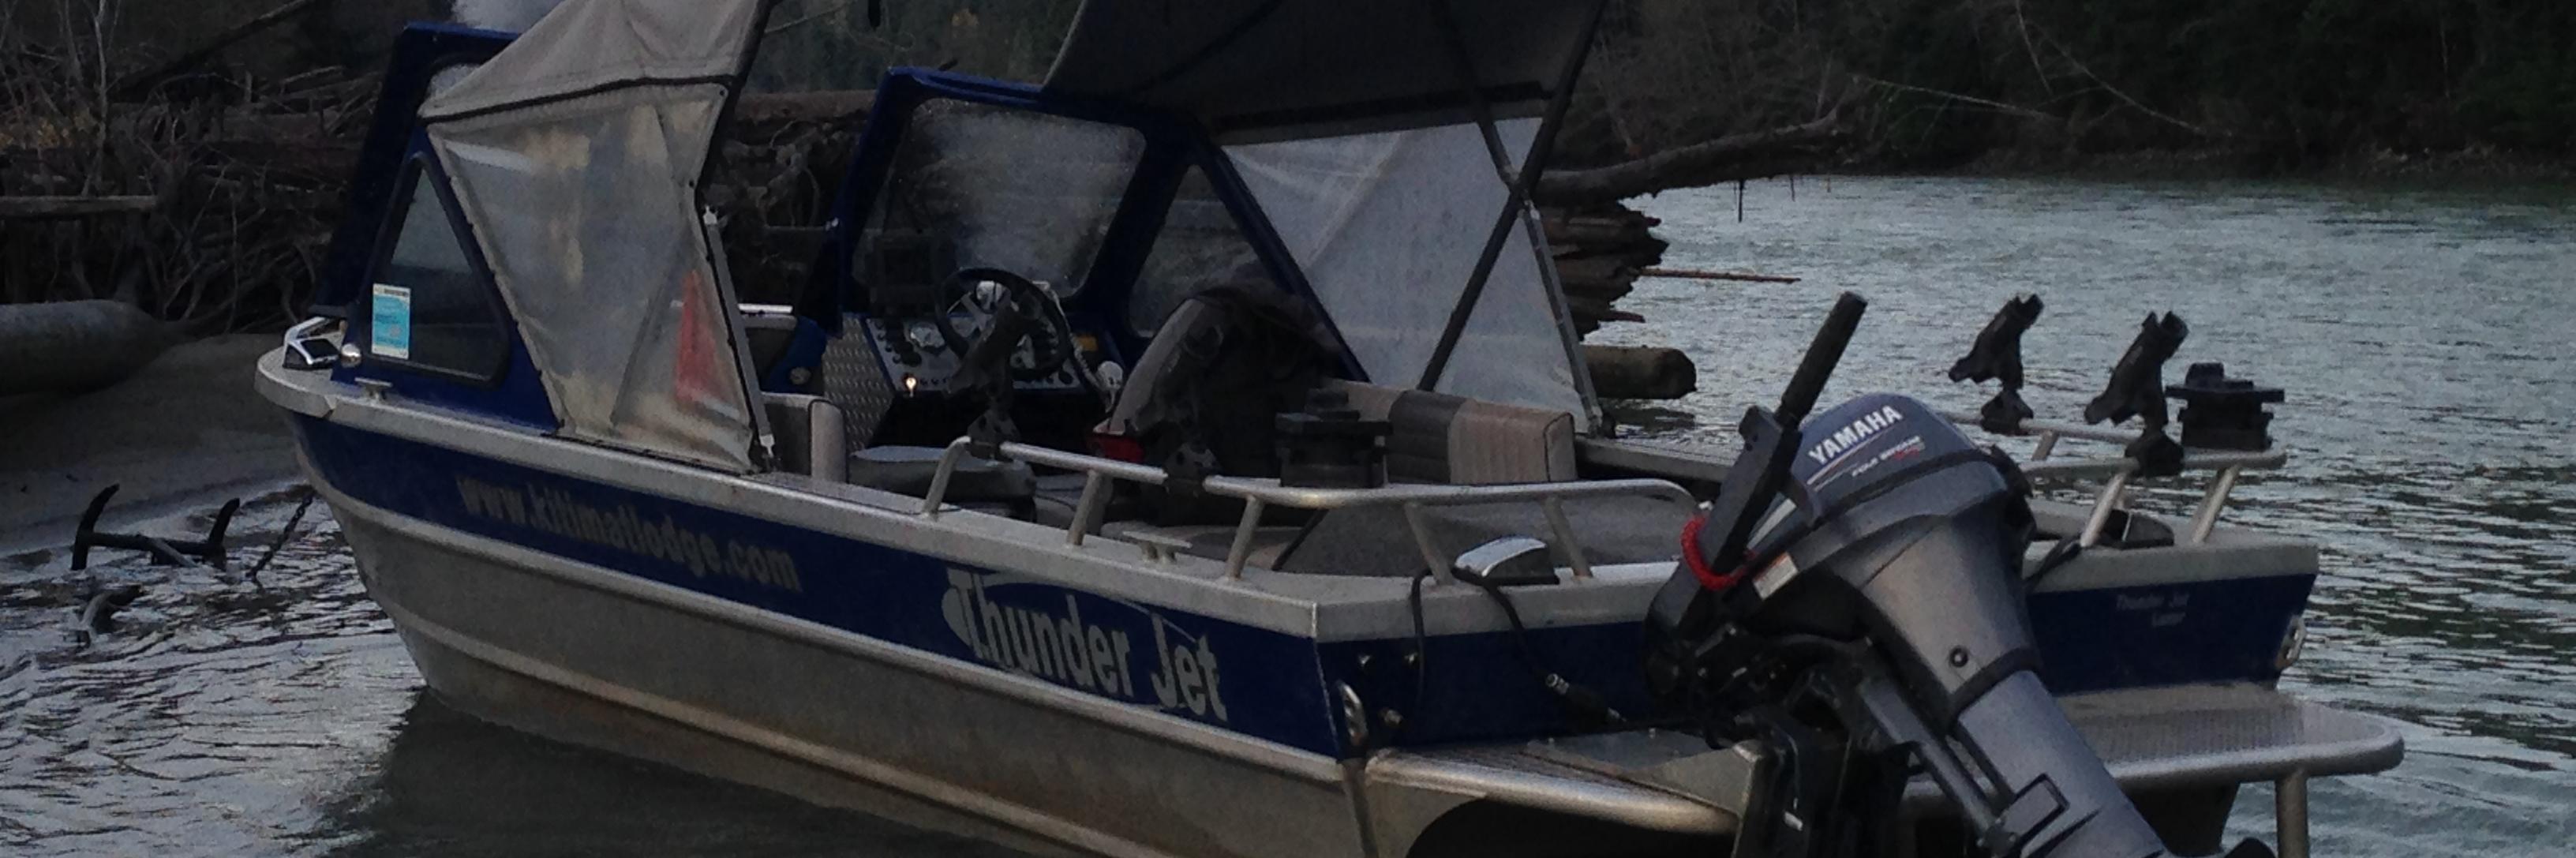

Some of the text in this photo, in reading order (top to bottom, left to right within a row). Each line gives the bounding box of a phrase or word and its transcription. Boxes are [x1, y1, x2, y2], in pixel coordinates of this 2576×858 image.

[1808, 404, 1904, 466] YAMAHA
[455, 475, 803, 594] www.kitimatlodge.com
[945, 567, 1229, 722] Thunder Jet
